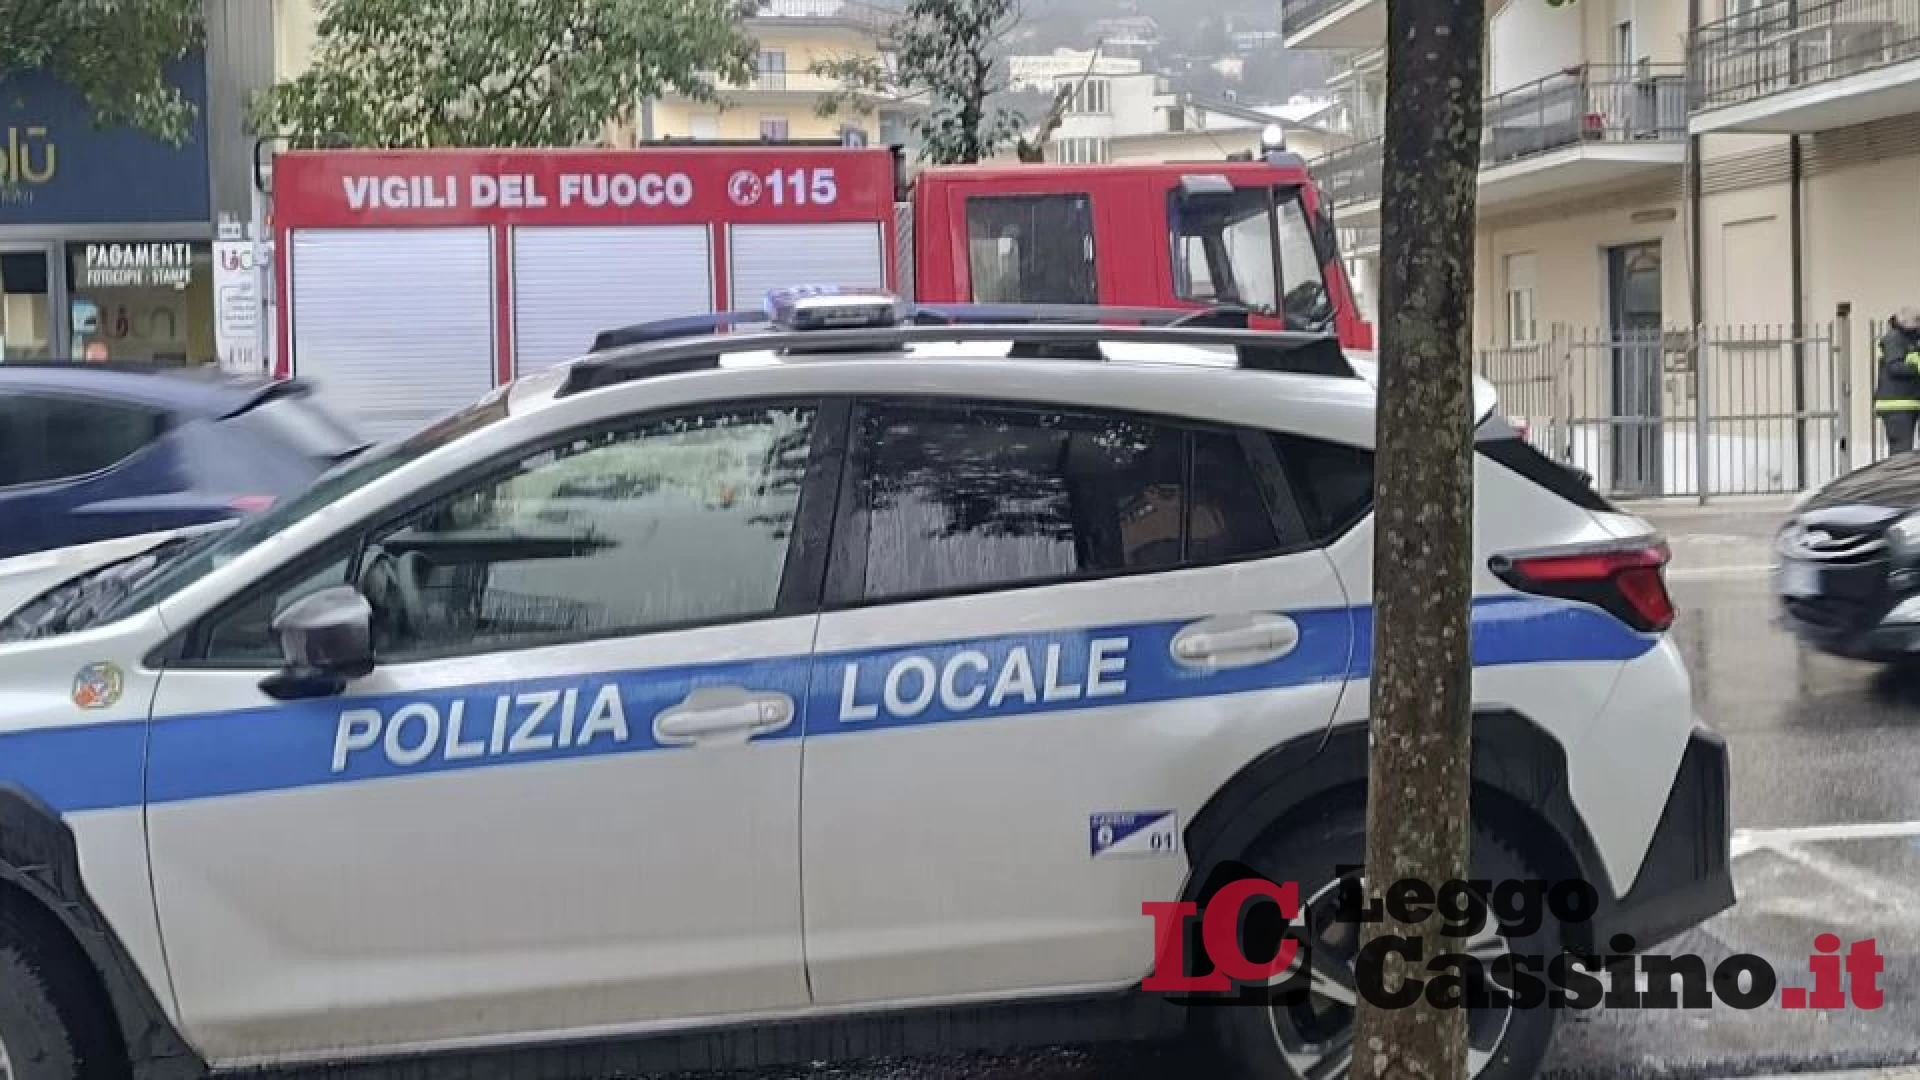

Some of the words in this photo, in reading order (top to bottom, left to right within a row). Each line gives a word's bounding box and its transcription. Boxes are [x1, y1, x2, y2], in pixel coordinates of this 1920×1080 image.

[342, 175, 457, 209] VIGILI
[470, 174, 548, 207] DEL
[559, 172, 693, 206] FUOCO
[765, 168, 837, 204] 115
[86, 243, 191, 268] PAGAMENTI
[331, 683, 628, 772] POLIZIA
[839, 637, 1129, 722] LOCALE
[1150, 832, 1172, 851] 01
